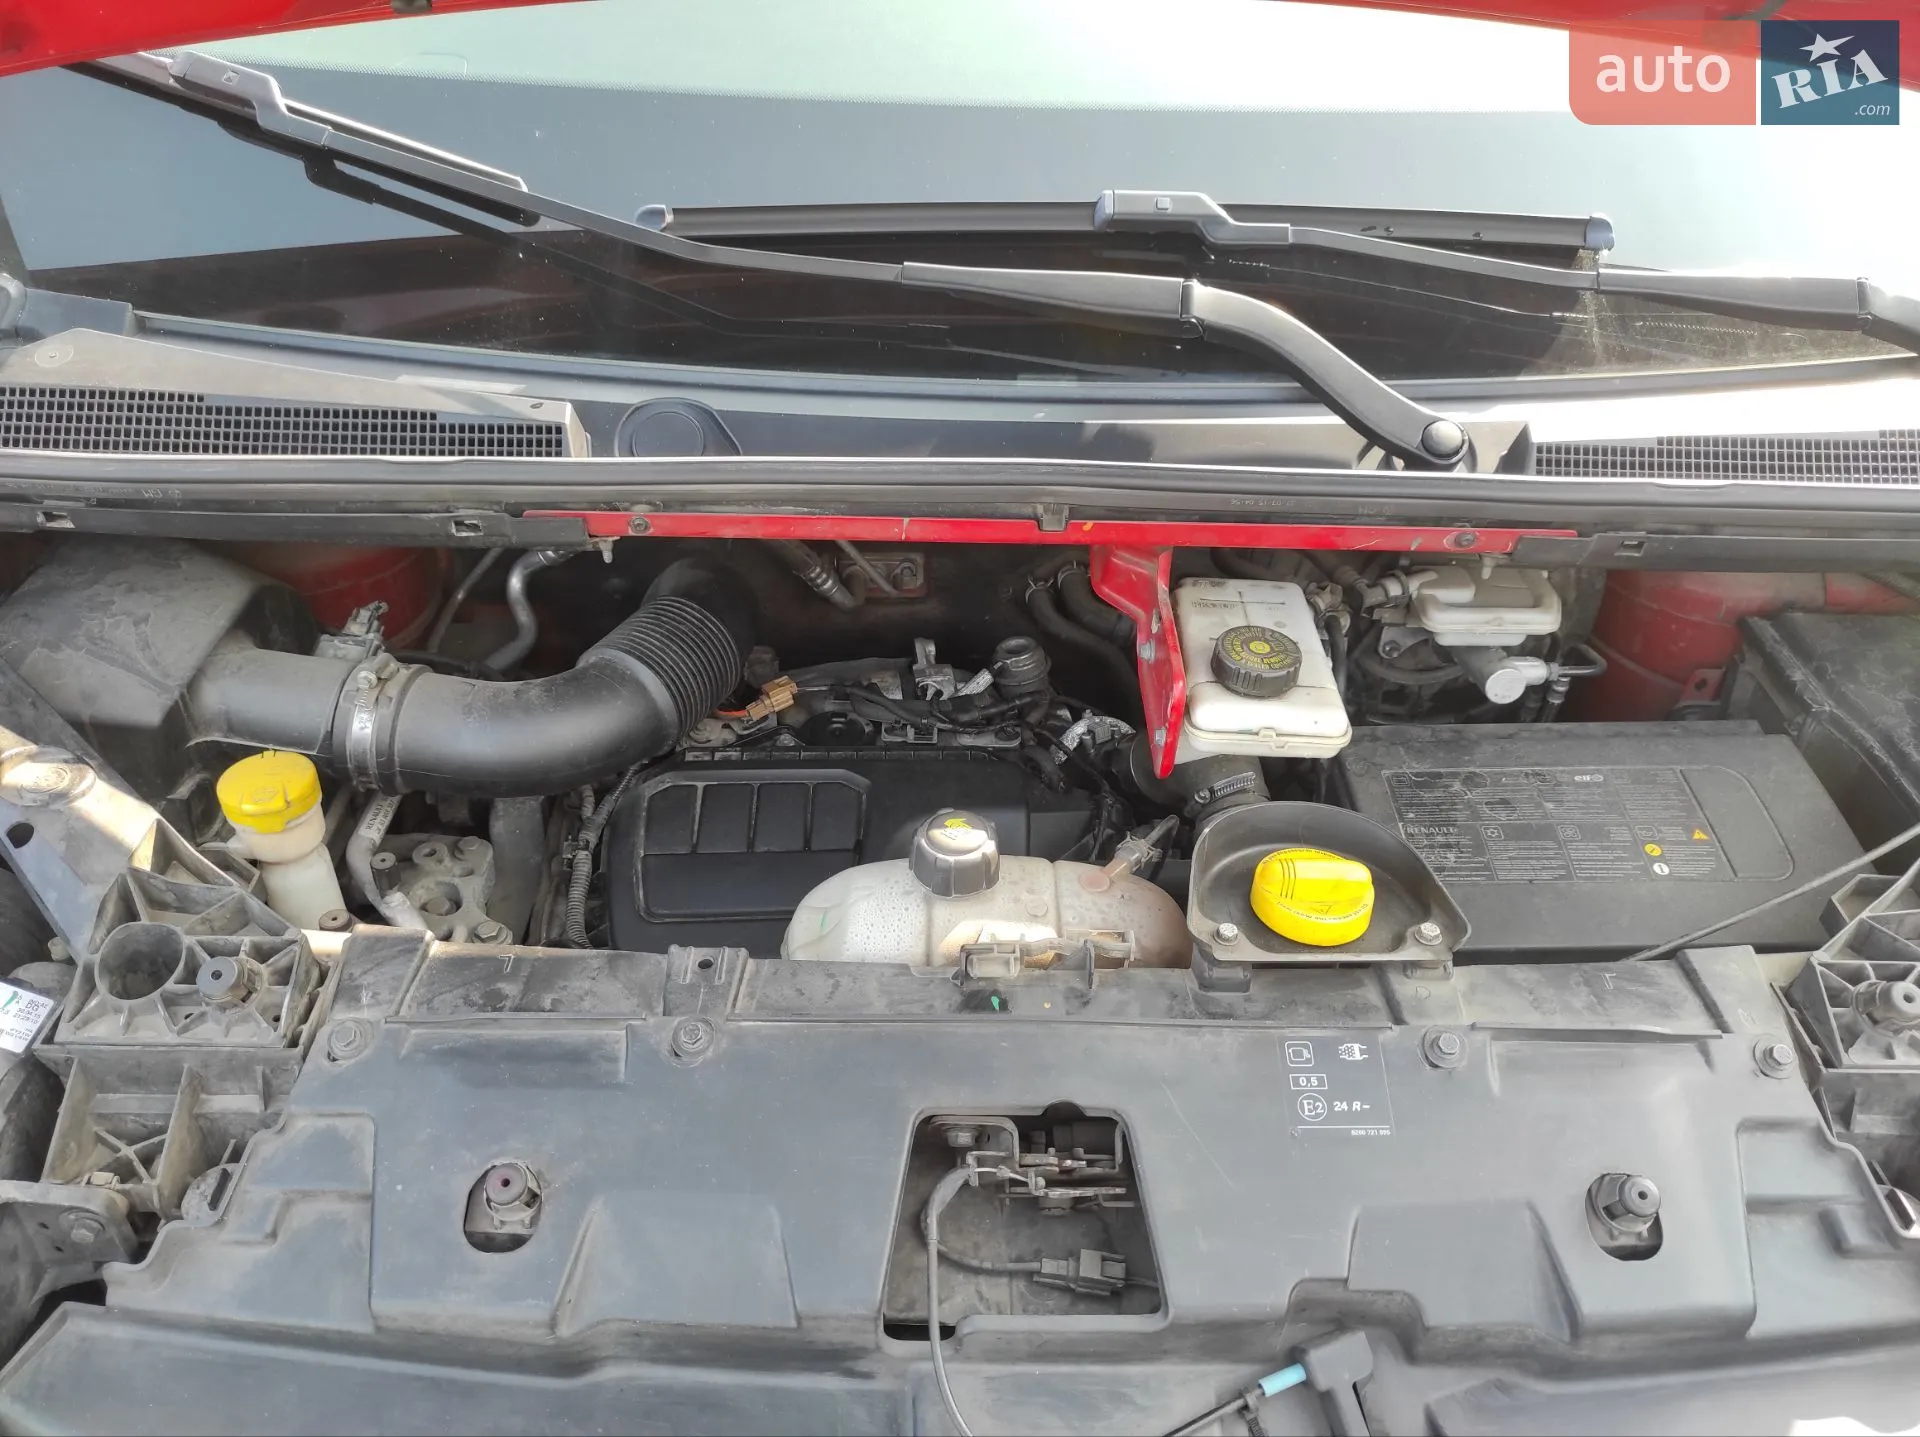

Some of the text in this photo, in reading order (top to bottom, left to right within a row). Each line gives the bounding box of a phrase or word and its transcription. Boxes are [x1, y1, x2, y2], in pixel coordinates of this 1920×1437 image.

[1299, 1076, 1319, 1088] 0,5
[1302, 1099, 1325, 1115] E2
[1333, 1101, 1348, 1111] 24
